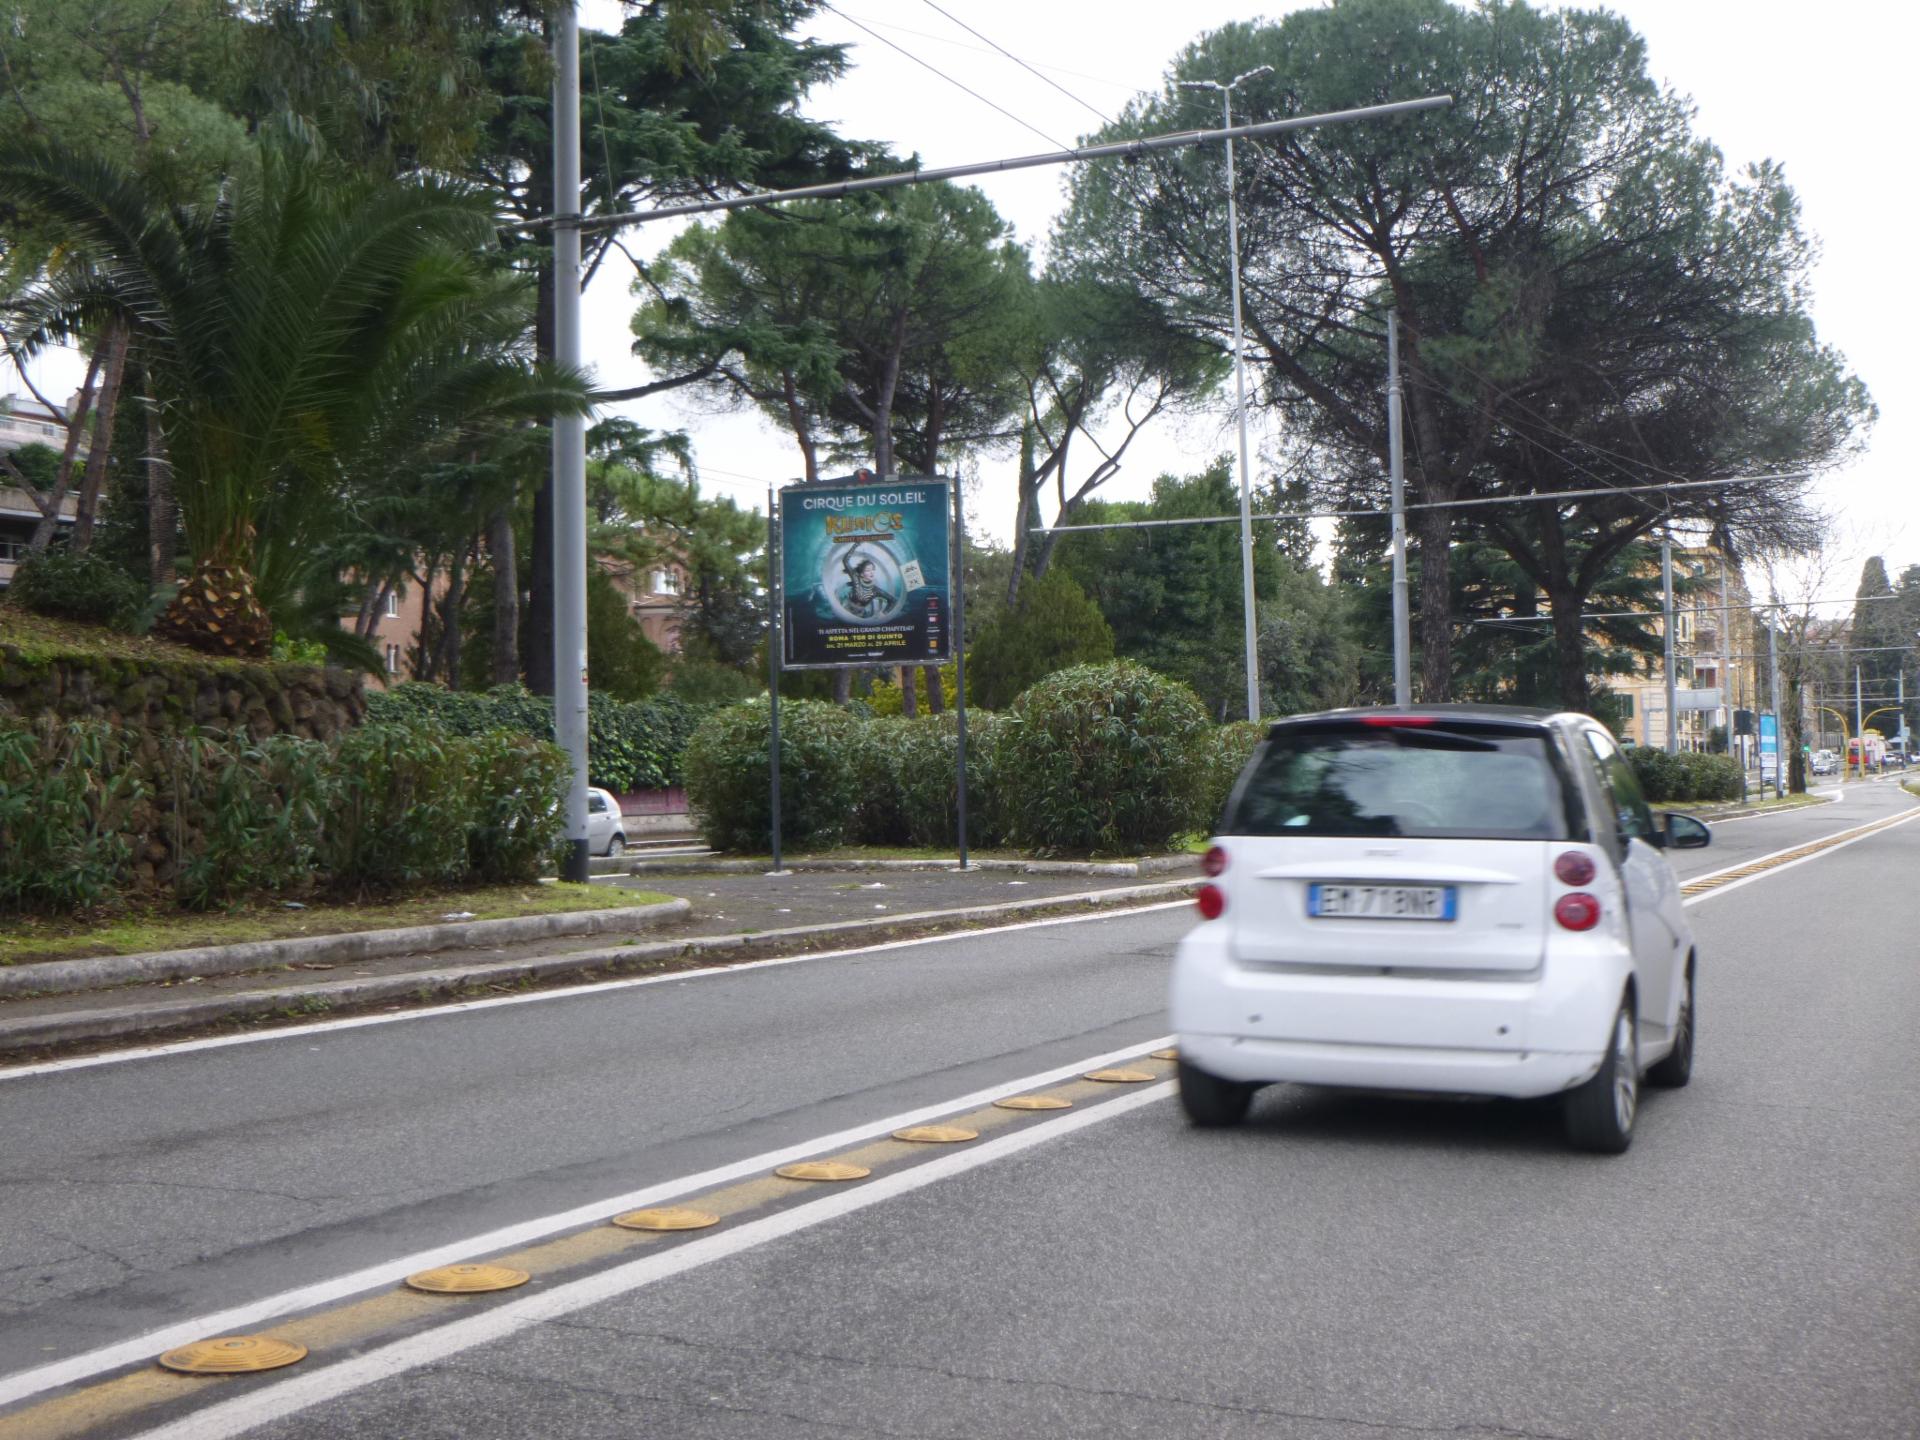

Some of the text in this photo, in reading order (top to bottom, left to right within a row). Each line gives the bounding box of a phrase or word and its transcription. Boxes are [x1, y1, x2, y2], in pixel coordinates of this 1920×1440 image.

[803, 491, 926, 511] CIRQUE DU SOLEIL
